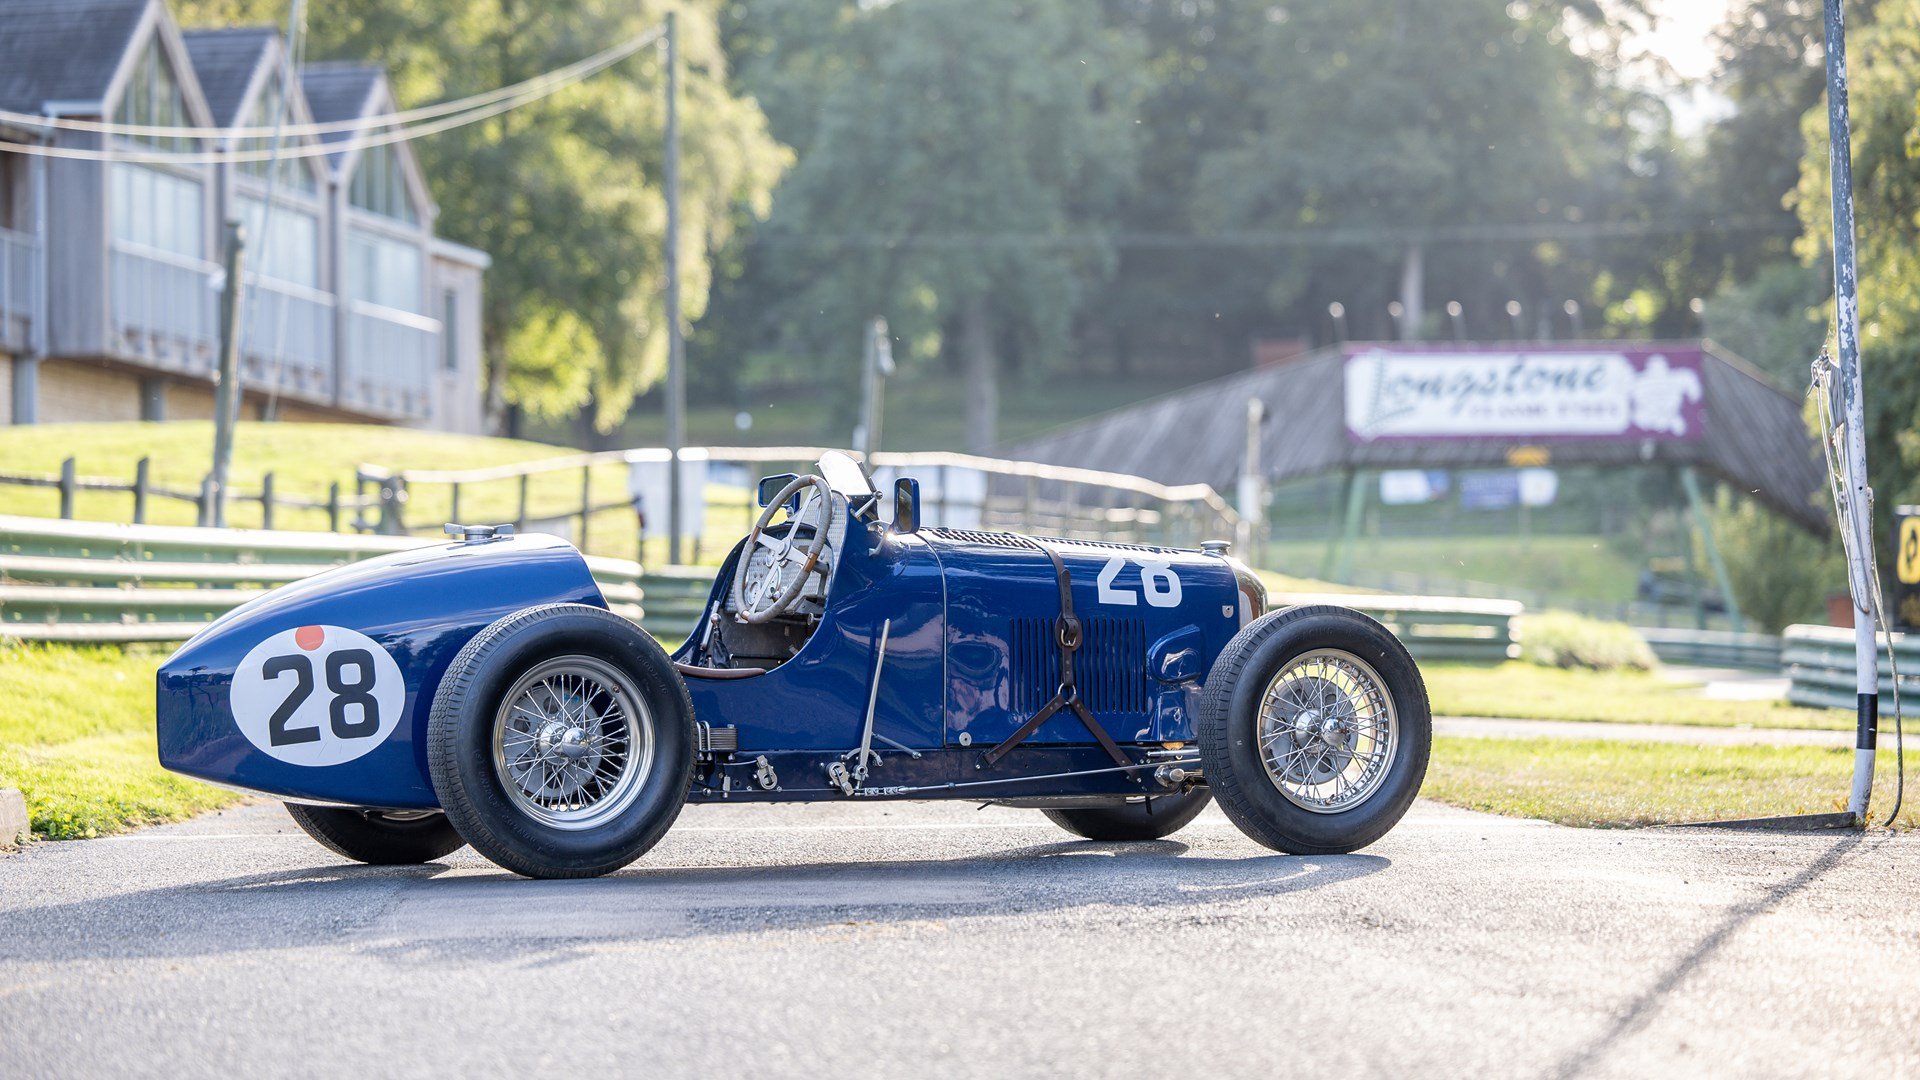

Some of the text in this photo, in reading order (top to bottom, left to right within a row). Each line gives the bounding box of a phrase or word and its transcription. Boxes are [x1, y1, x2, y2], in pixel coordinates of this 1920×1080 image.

[1364, 350, 1606, 424] Longstone
[1097, 553, 1182, 607] 28
[262, 648, 380, 747] 28
